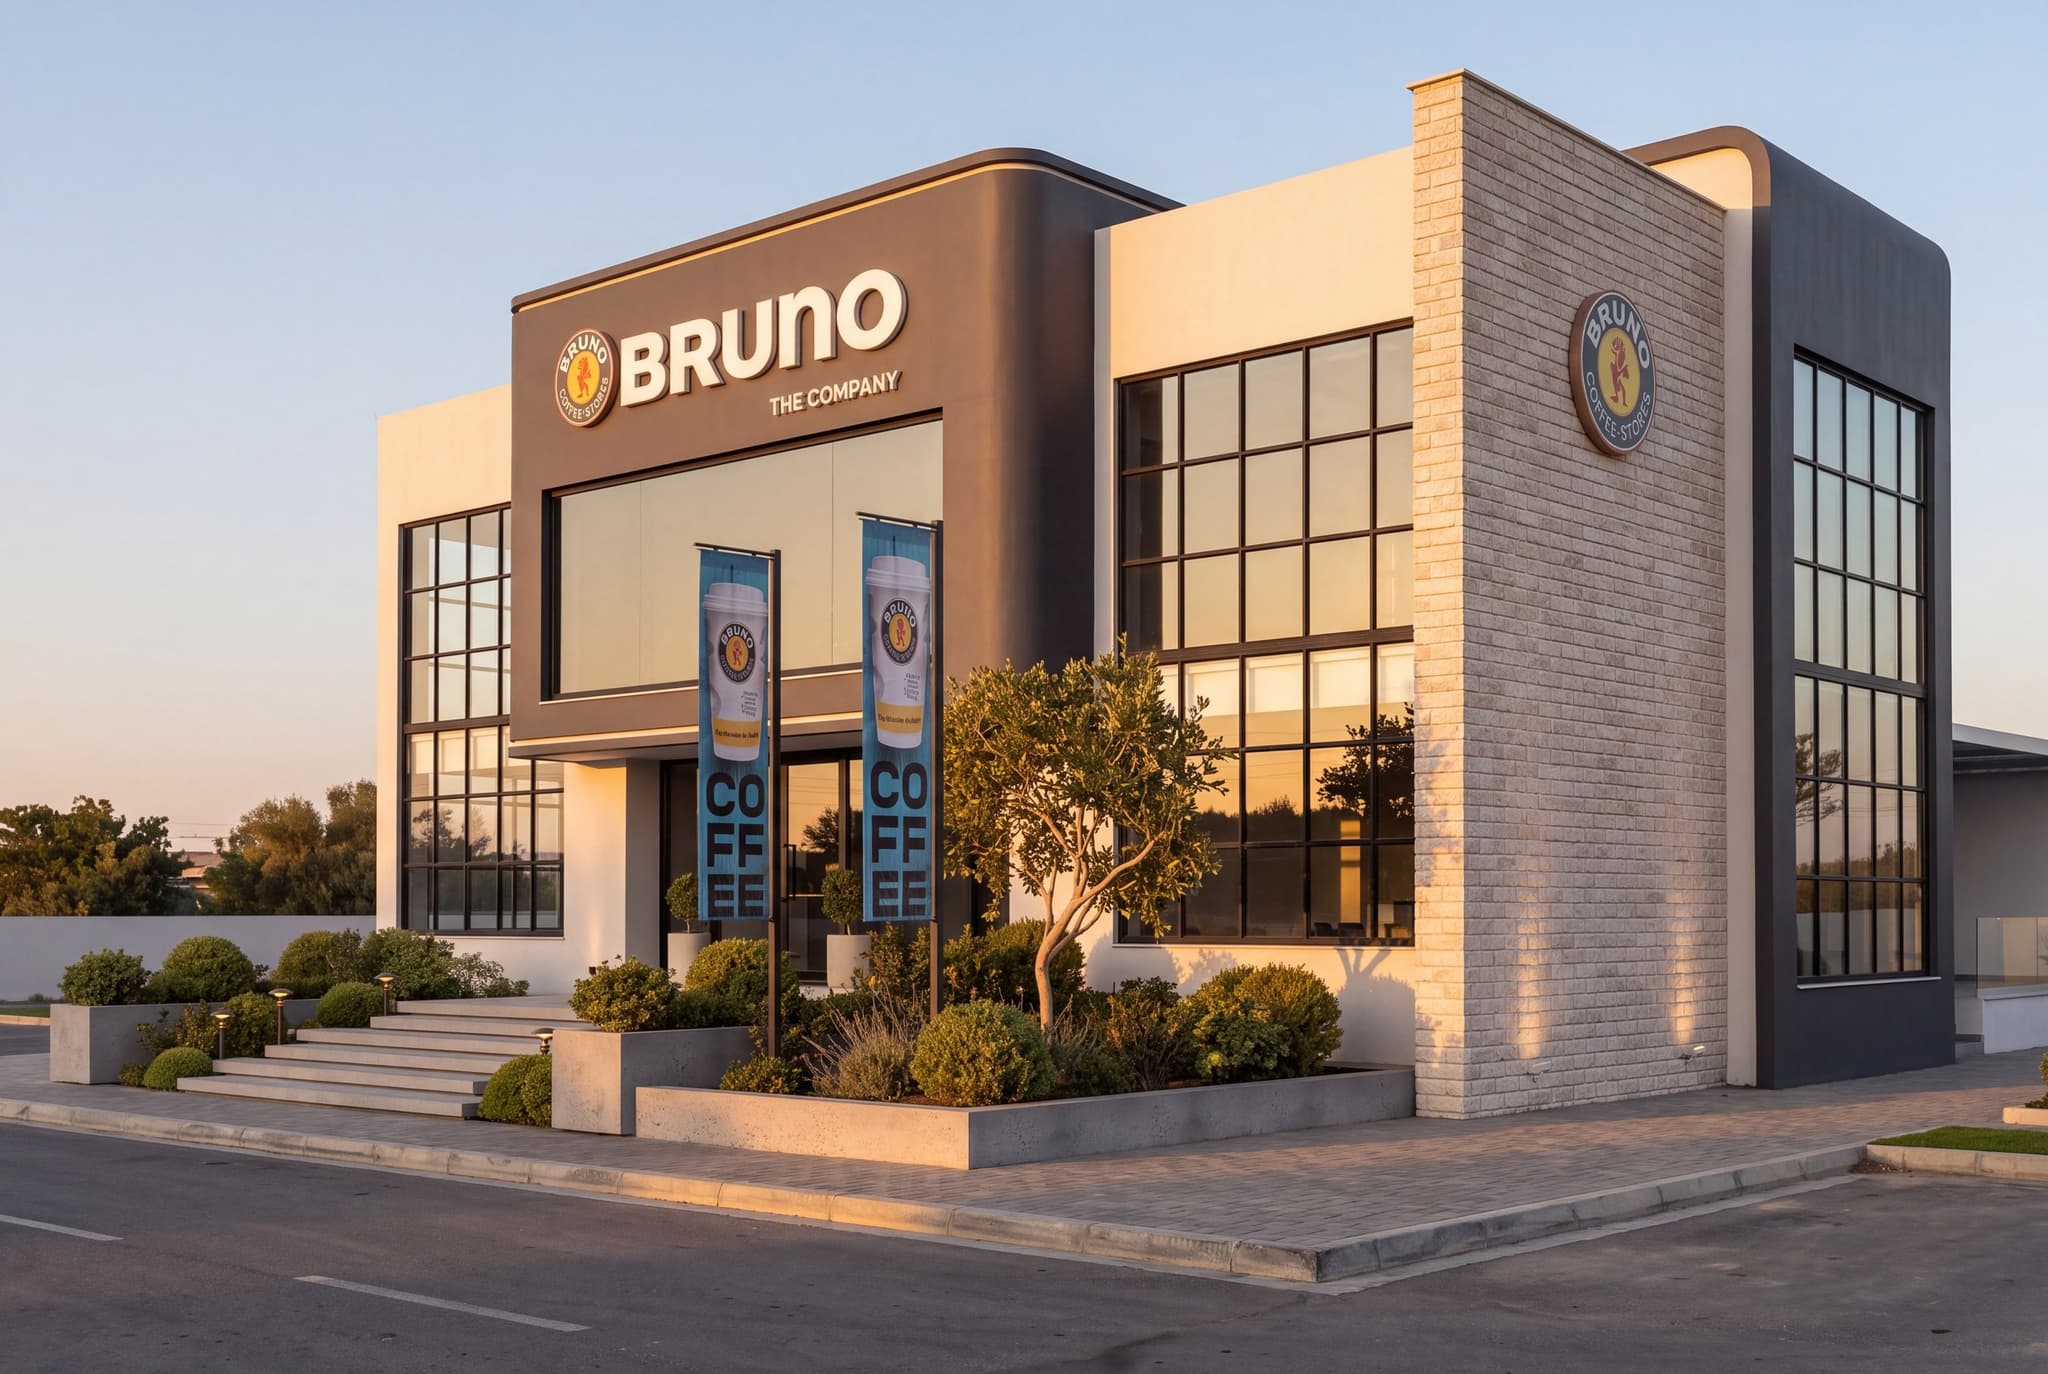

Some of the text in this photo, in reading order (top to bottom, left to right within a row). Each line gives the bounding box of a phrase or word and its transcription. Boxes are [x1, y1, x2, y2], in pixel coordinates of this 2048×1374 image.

[559, 334, 608, 373] BRUNO
[1586, 300, 1650, 369] BRUNO
[769, 370, 902, 417] THE COMPANY
